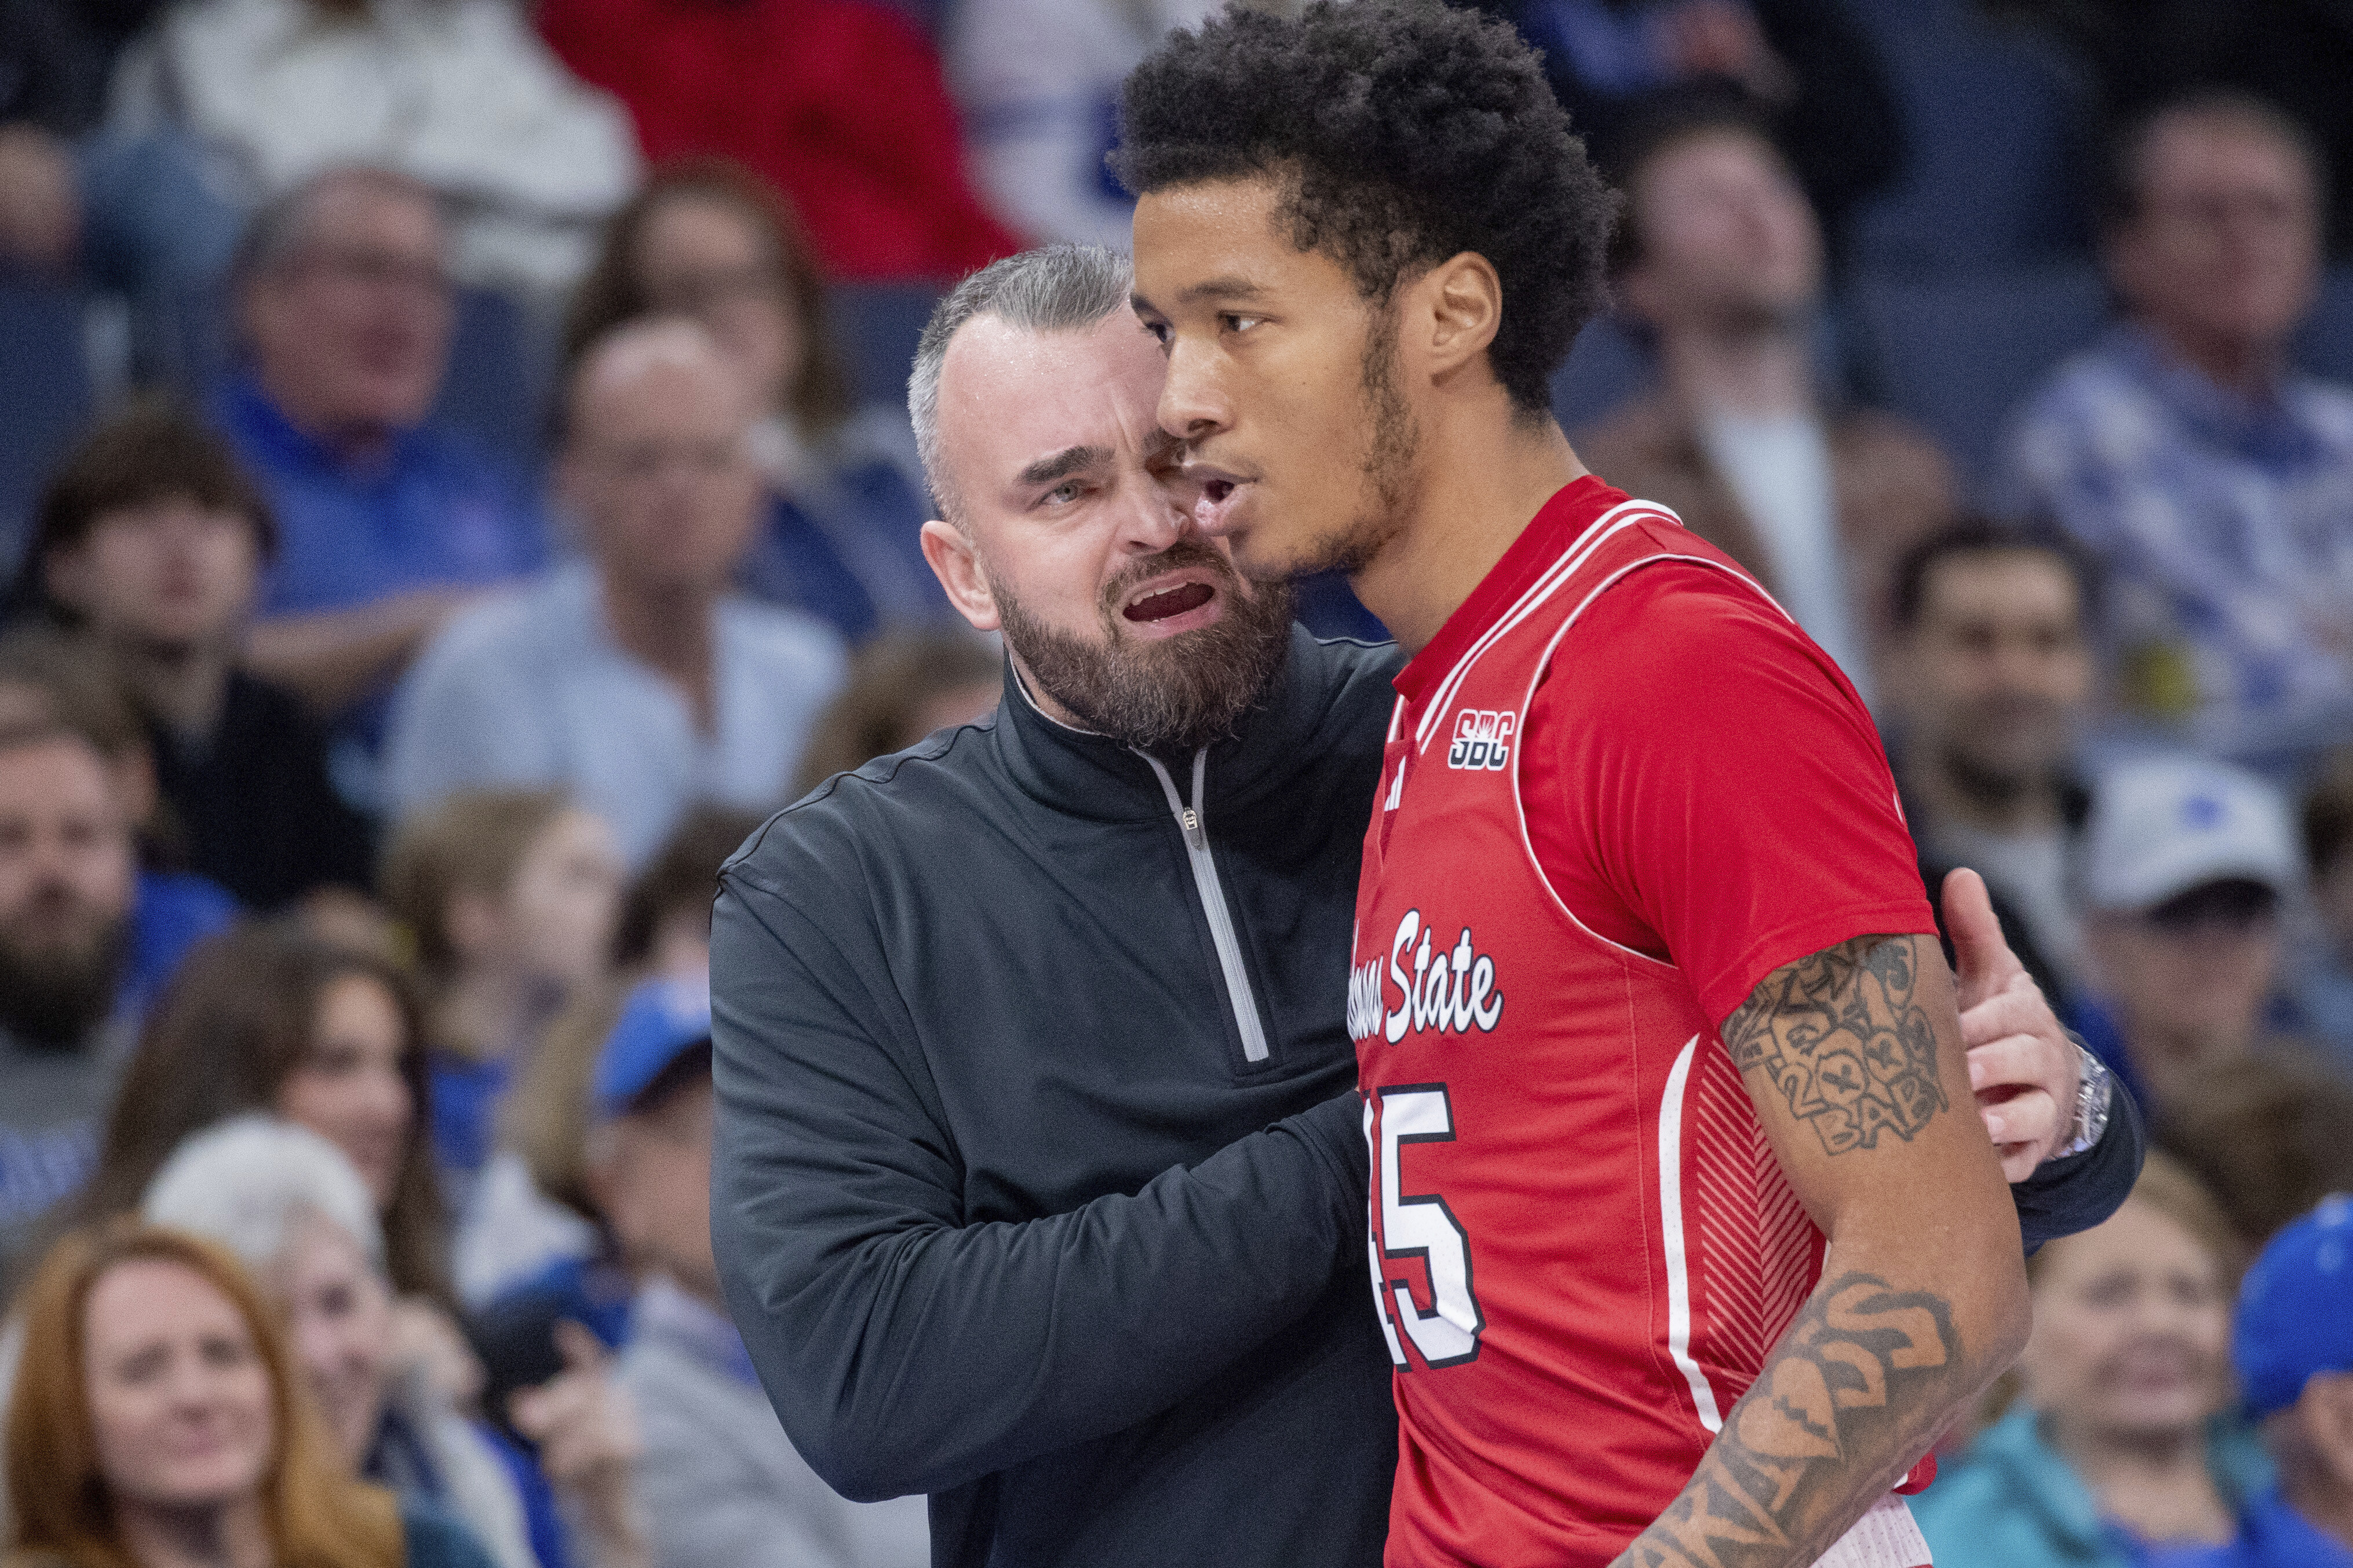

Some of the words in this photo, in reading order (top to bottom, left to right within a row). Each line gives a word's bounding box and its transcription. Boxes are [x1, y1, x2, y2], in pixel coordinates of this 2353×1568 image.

[1449, 708, 1516, 770] SBC
[1385, 908, 1504, 1045] State
[1362, 1082, 1486, 1373] 5
